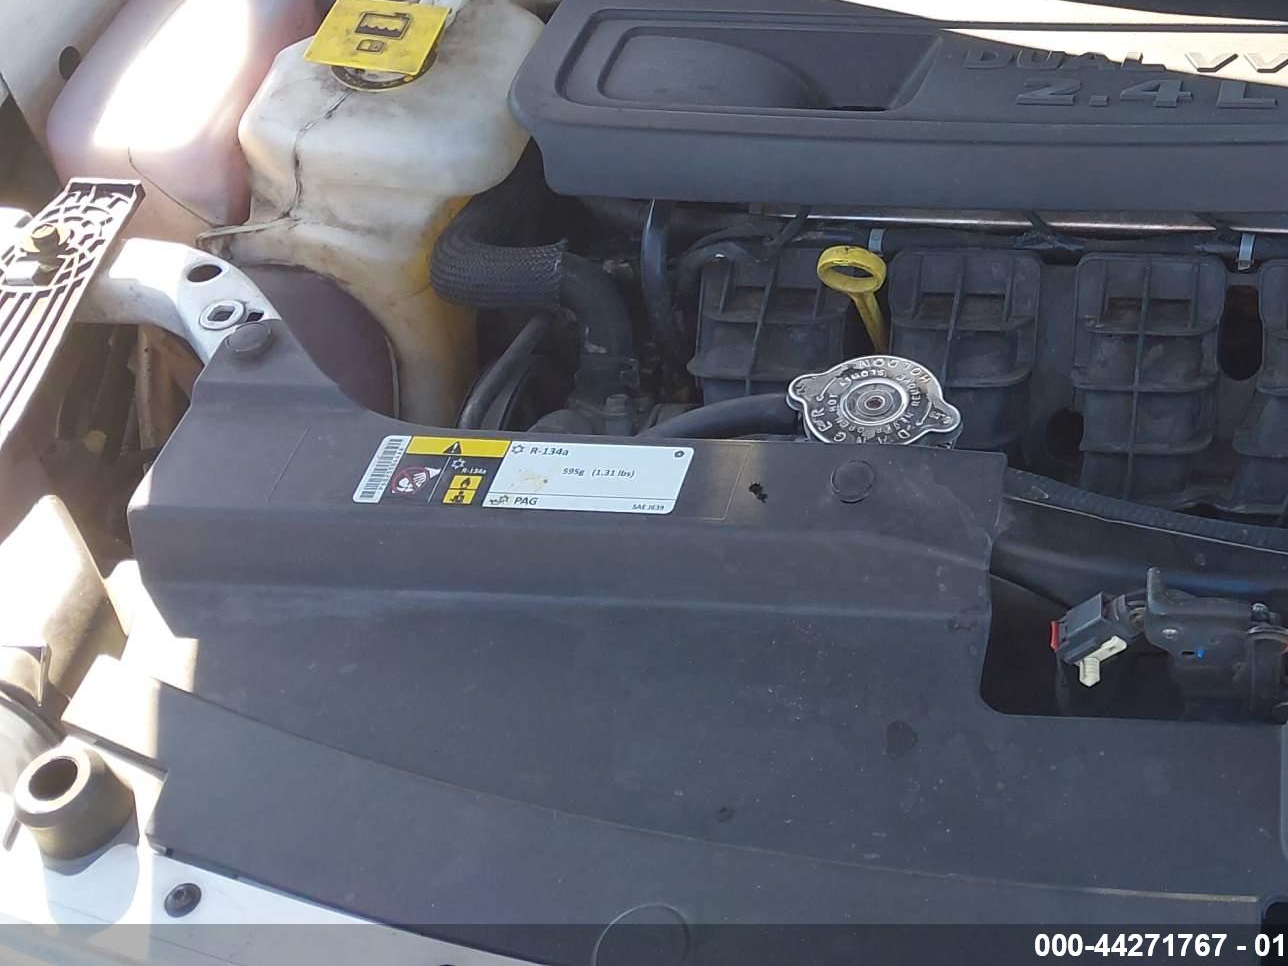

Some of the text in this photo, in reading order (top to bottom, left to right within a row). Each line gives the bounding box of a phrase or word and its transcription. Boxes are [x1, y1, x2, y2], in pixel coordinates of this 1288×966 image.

[962, 50, 1168, 72] DUAL
[529, 446, 569, 457] R-134a
[562, 467, 635, 479] 595g (1.31 lbs)
[513, 496, 539, 506] PAG
[632, 503, 647, 511] SAE
